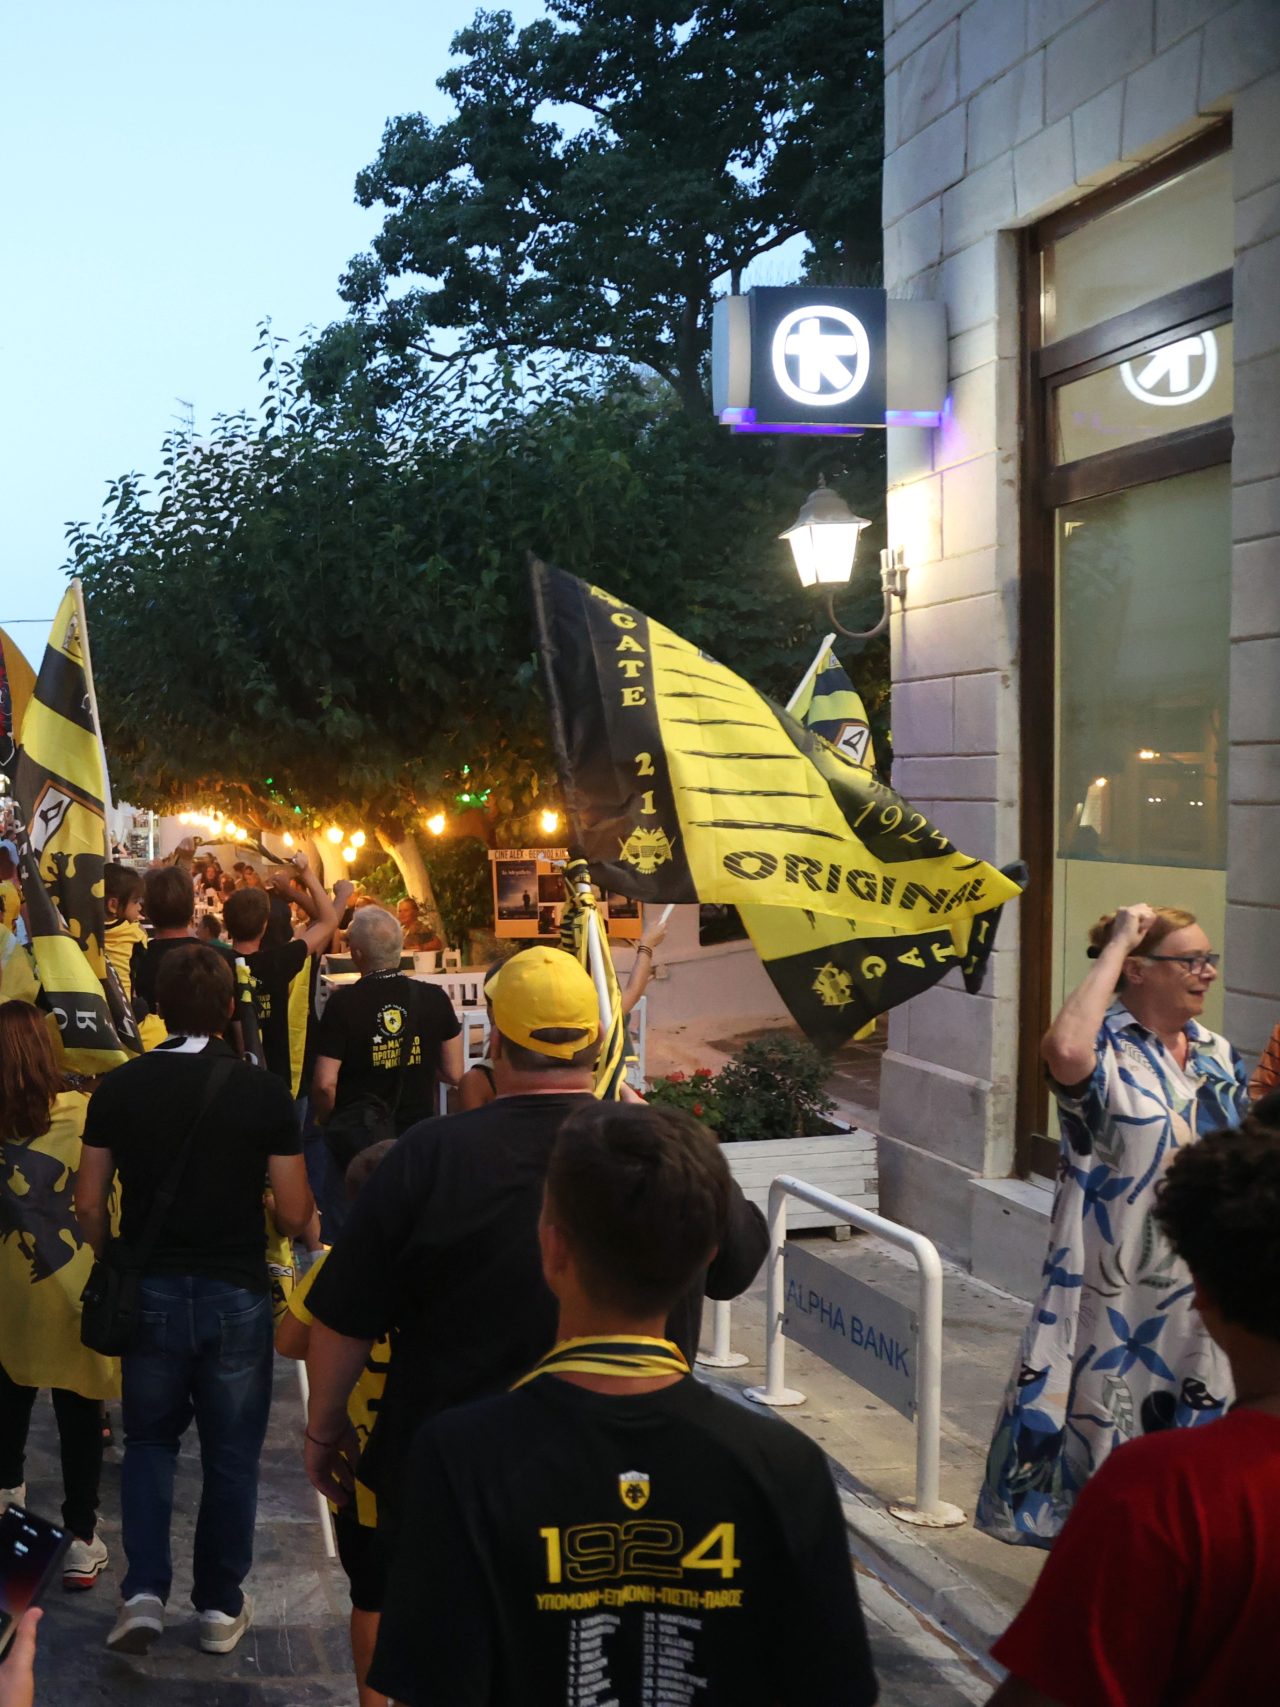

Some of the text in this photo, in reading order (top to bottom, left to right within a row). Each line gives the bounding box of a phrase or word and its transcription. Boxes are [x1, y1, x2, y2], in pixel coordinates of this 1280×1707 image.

[610, 612, 657, 816] GATE 21
[723, 850, 987, 915] ORIGINAL
[786, 1279, 910, 1377] ALPHA BANK
[538, 1519, 742, 1584] 1924
